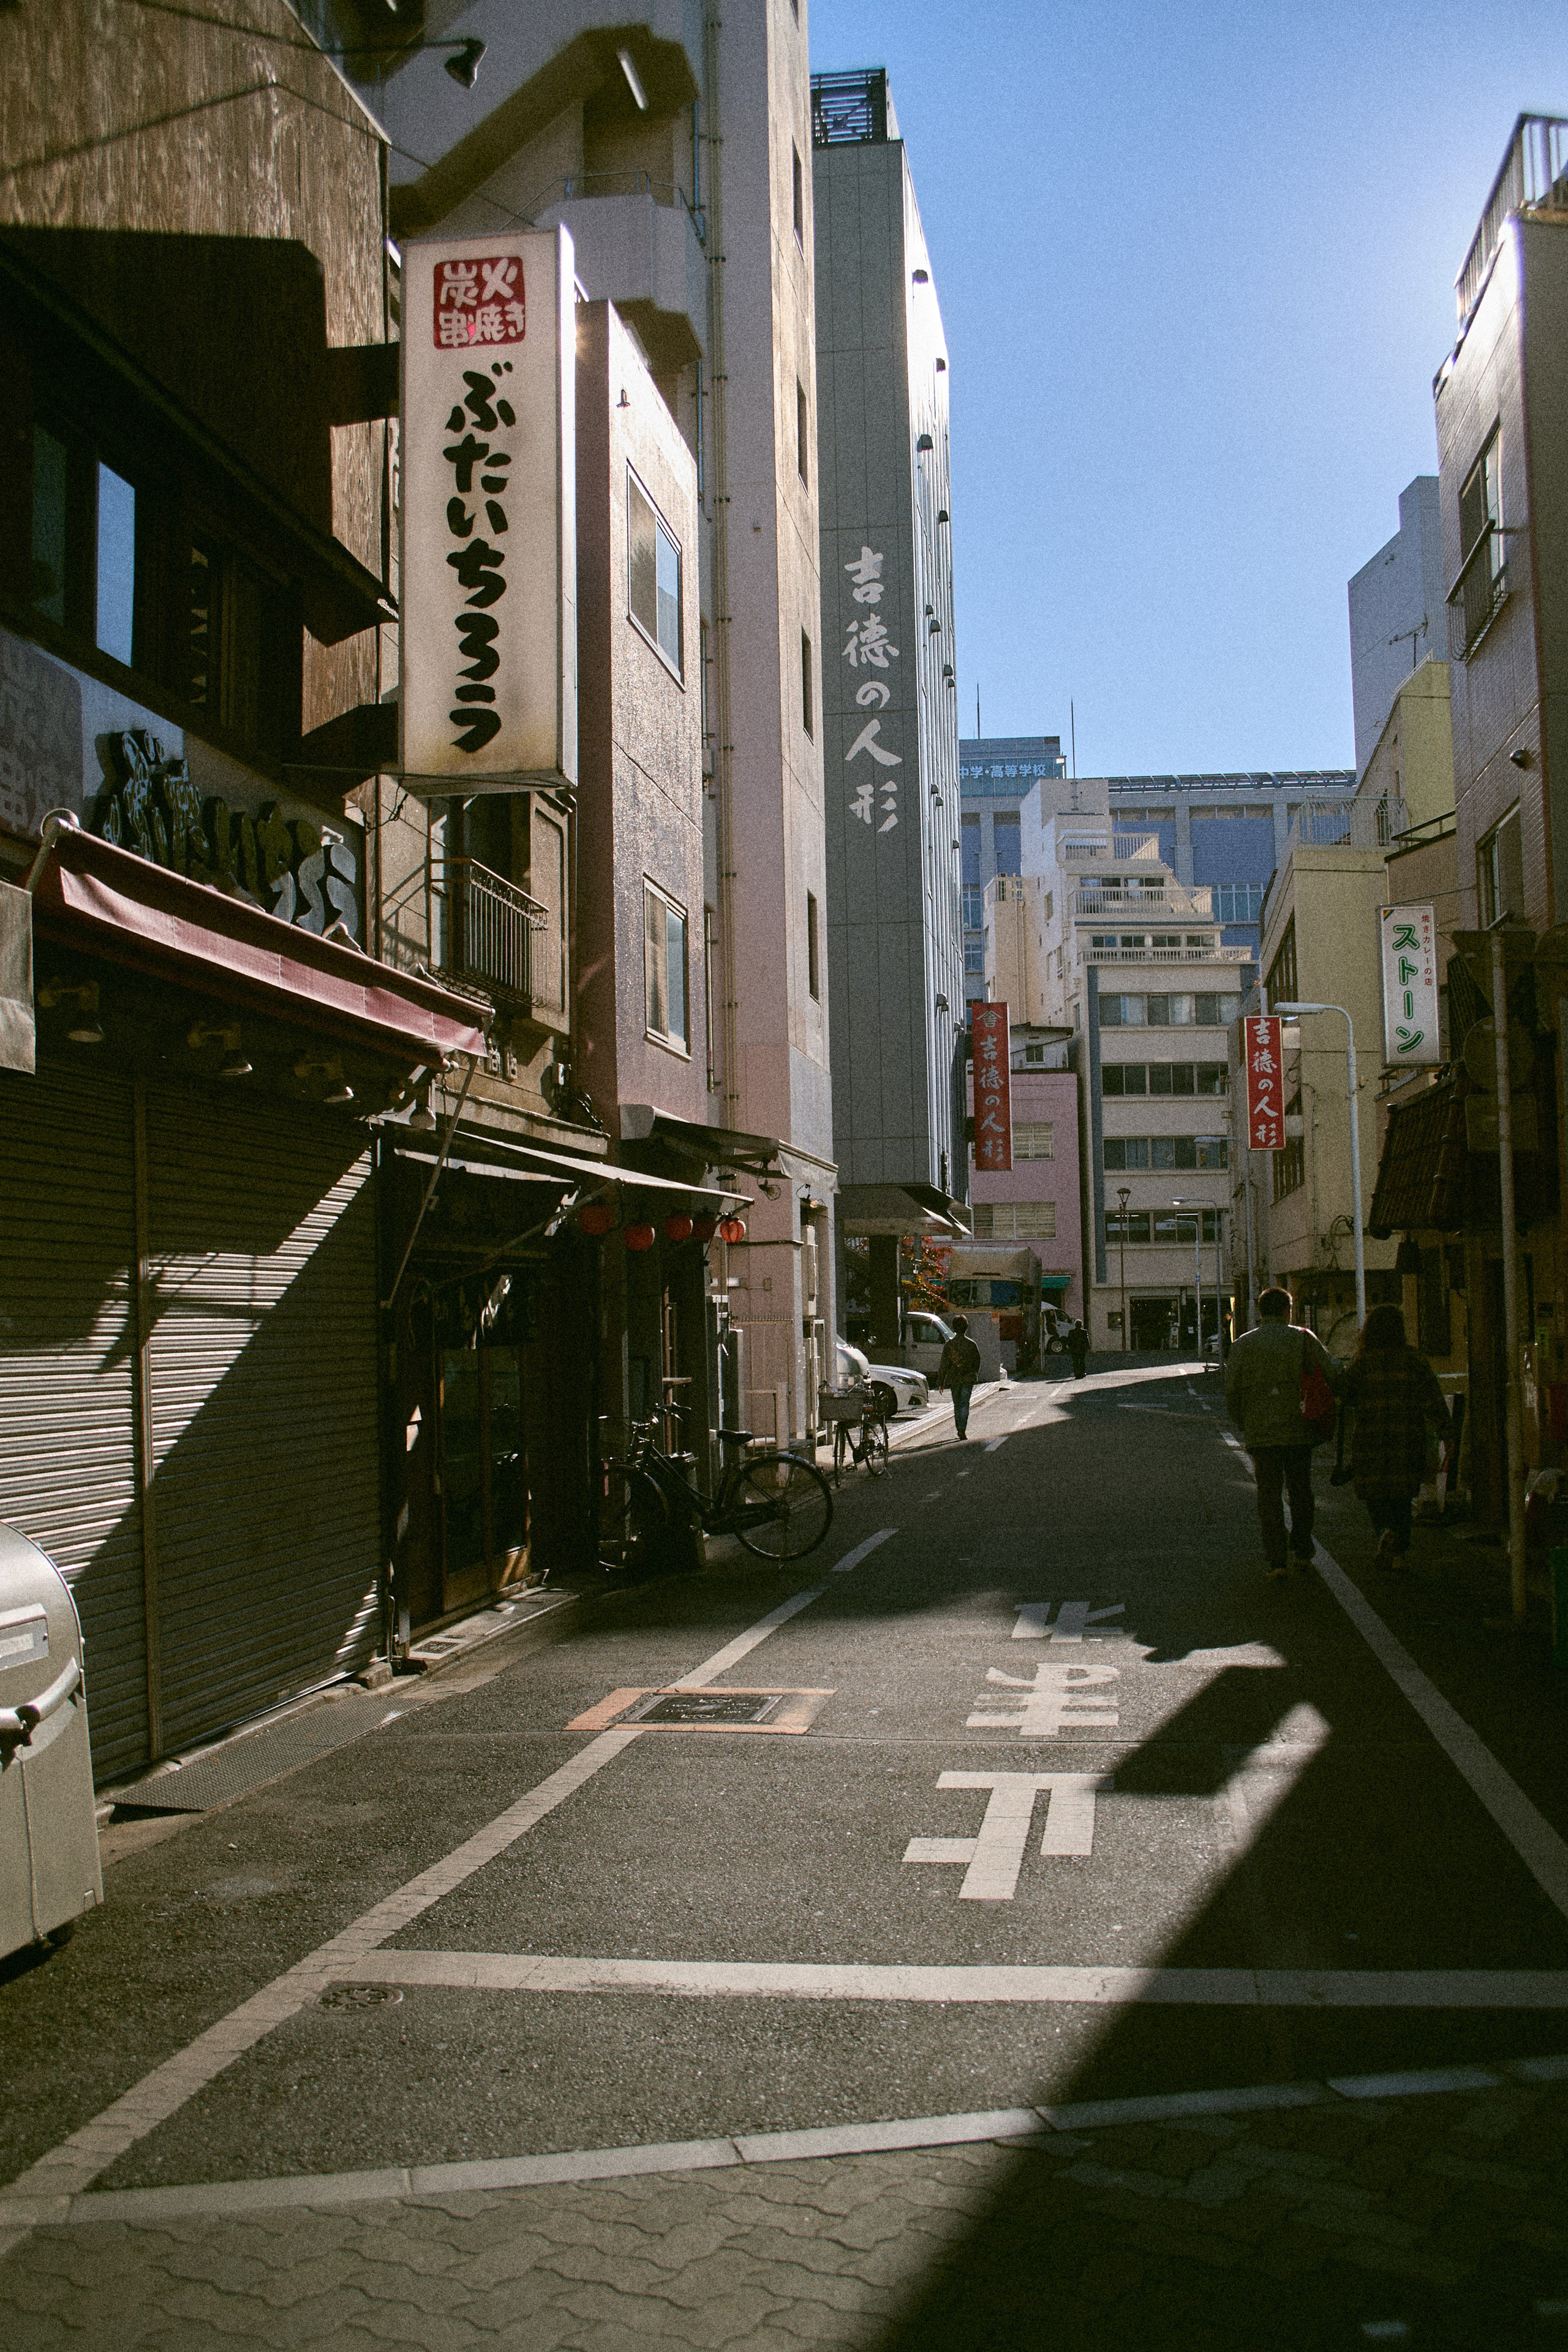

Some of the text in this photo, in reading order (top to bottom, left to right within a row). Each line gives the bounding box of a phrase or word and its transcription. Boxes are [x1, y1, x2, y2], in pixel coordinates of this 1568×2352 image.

[440, 258, 518, 308] 炭火
[439, 301, 526, 347] 串焼き
[442, 361, 516, 754] ぶたいちろう
[1421, 914, 1433, 986] 焼きカレーの店
[1392, 924, 1424, 1054] ストーン
